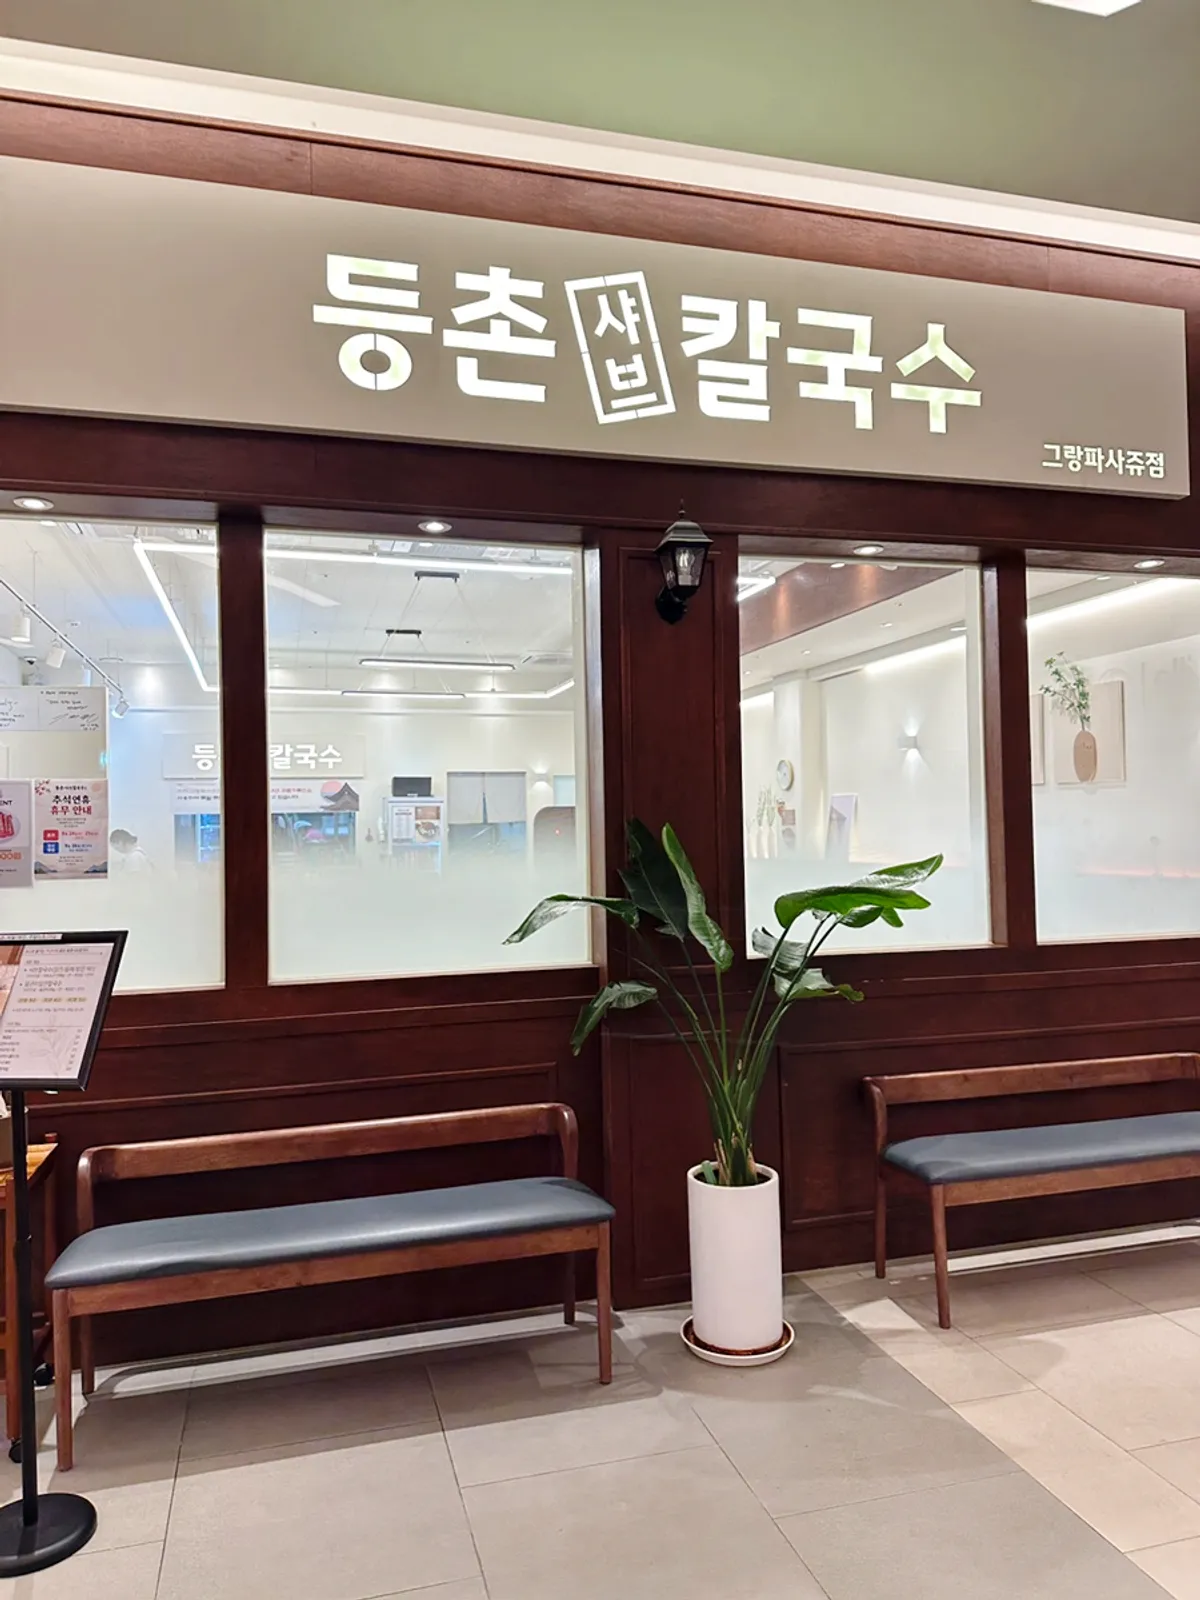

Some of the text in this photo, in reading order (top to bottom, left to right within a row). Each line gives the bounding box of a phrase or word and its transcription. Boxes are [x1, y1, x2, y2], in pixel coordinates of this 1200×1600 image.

[312, 254, 982, 434] 등촌 샤브 칼국수
[1041, 443, 1165, 479] 그랑파사쥬점
[191, 743, 219, 771] 등
[270, 743, 343, 770] 칼국수
[50, 805, 92, 815] 휴무 안내
[52, 795, 91, 804] 추석연휴
